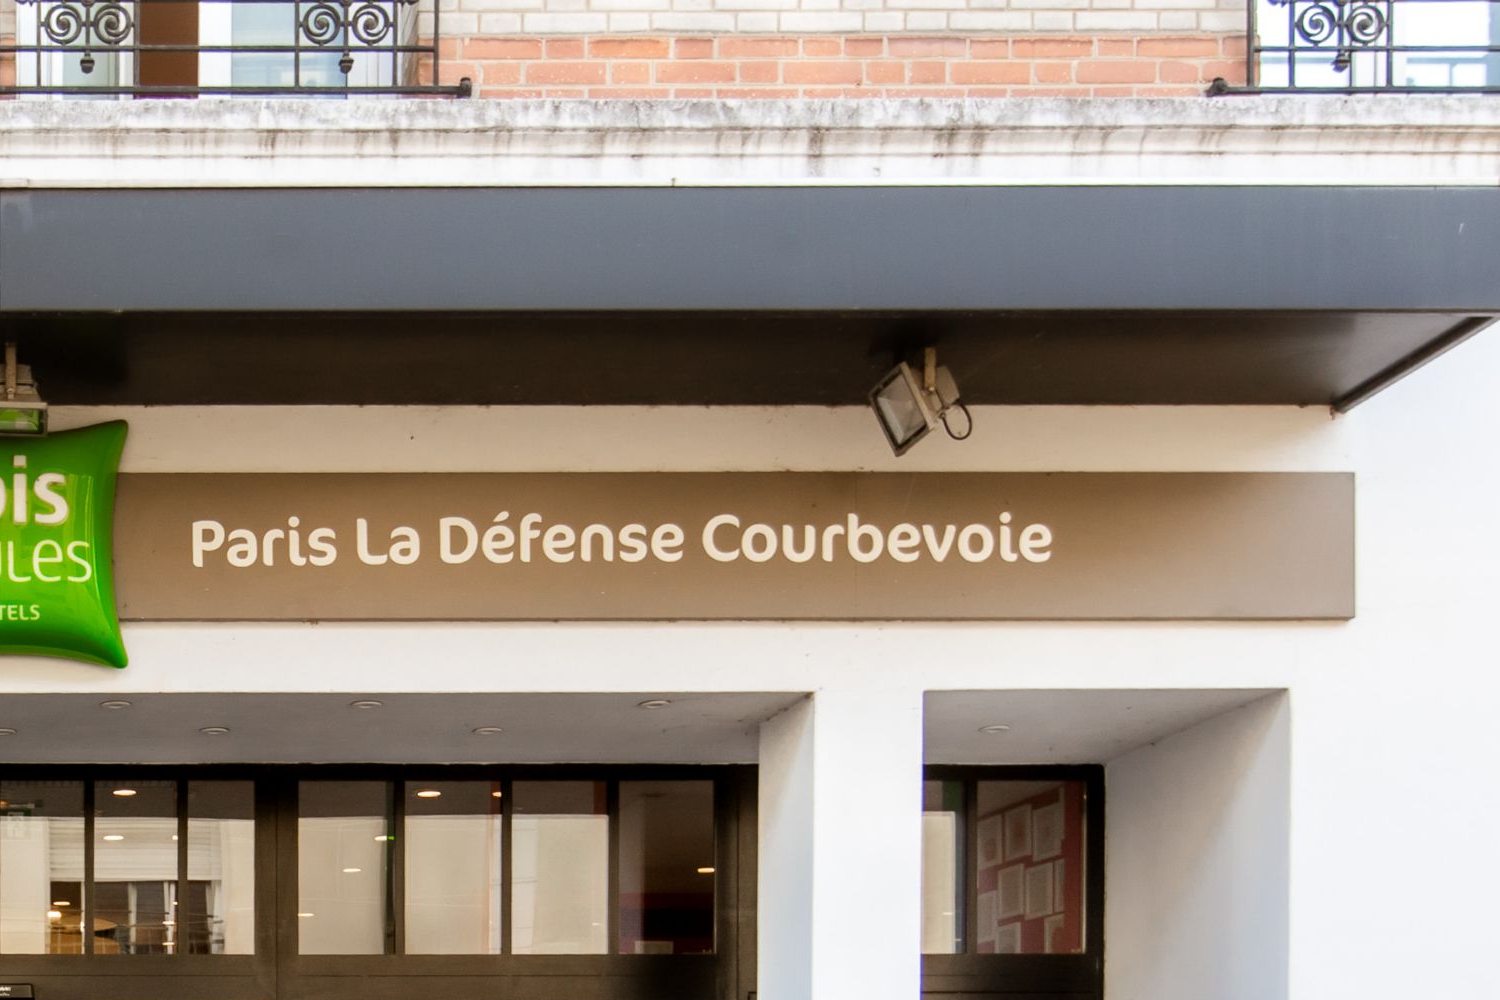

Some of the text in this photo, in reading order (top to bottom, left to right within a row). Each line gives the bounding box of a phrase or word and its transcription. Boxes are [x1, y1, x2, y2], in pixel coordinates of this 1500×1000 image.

[191, 511, 1053, 568] Paris La Défense Courbevoie
